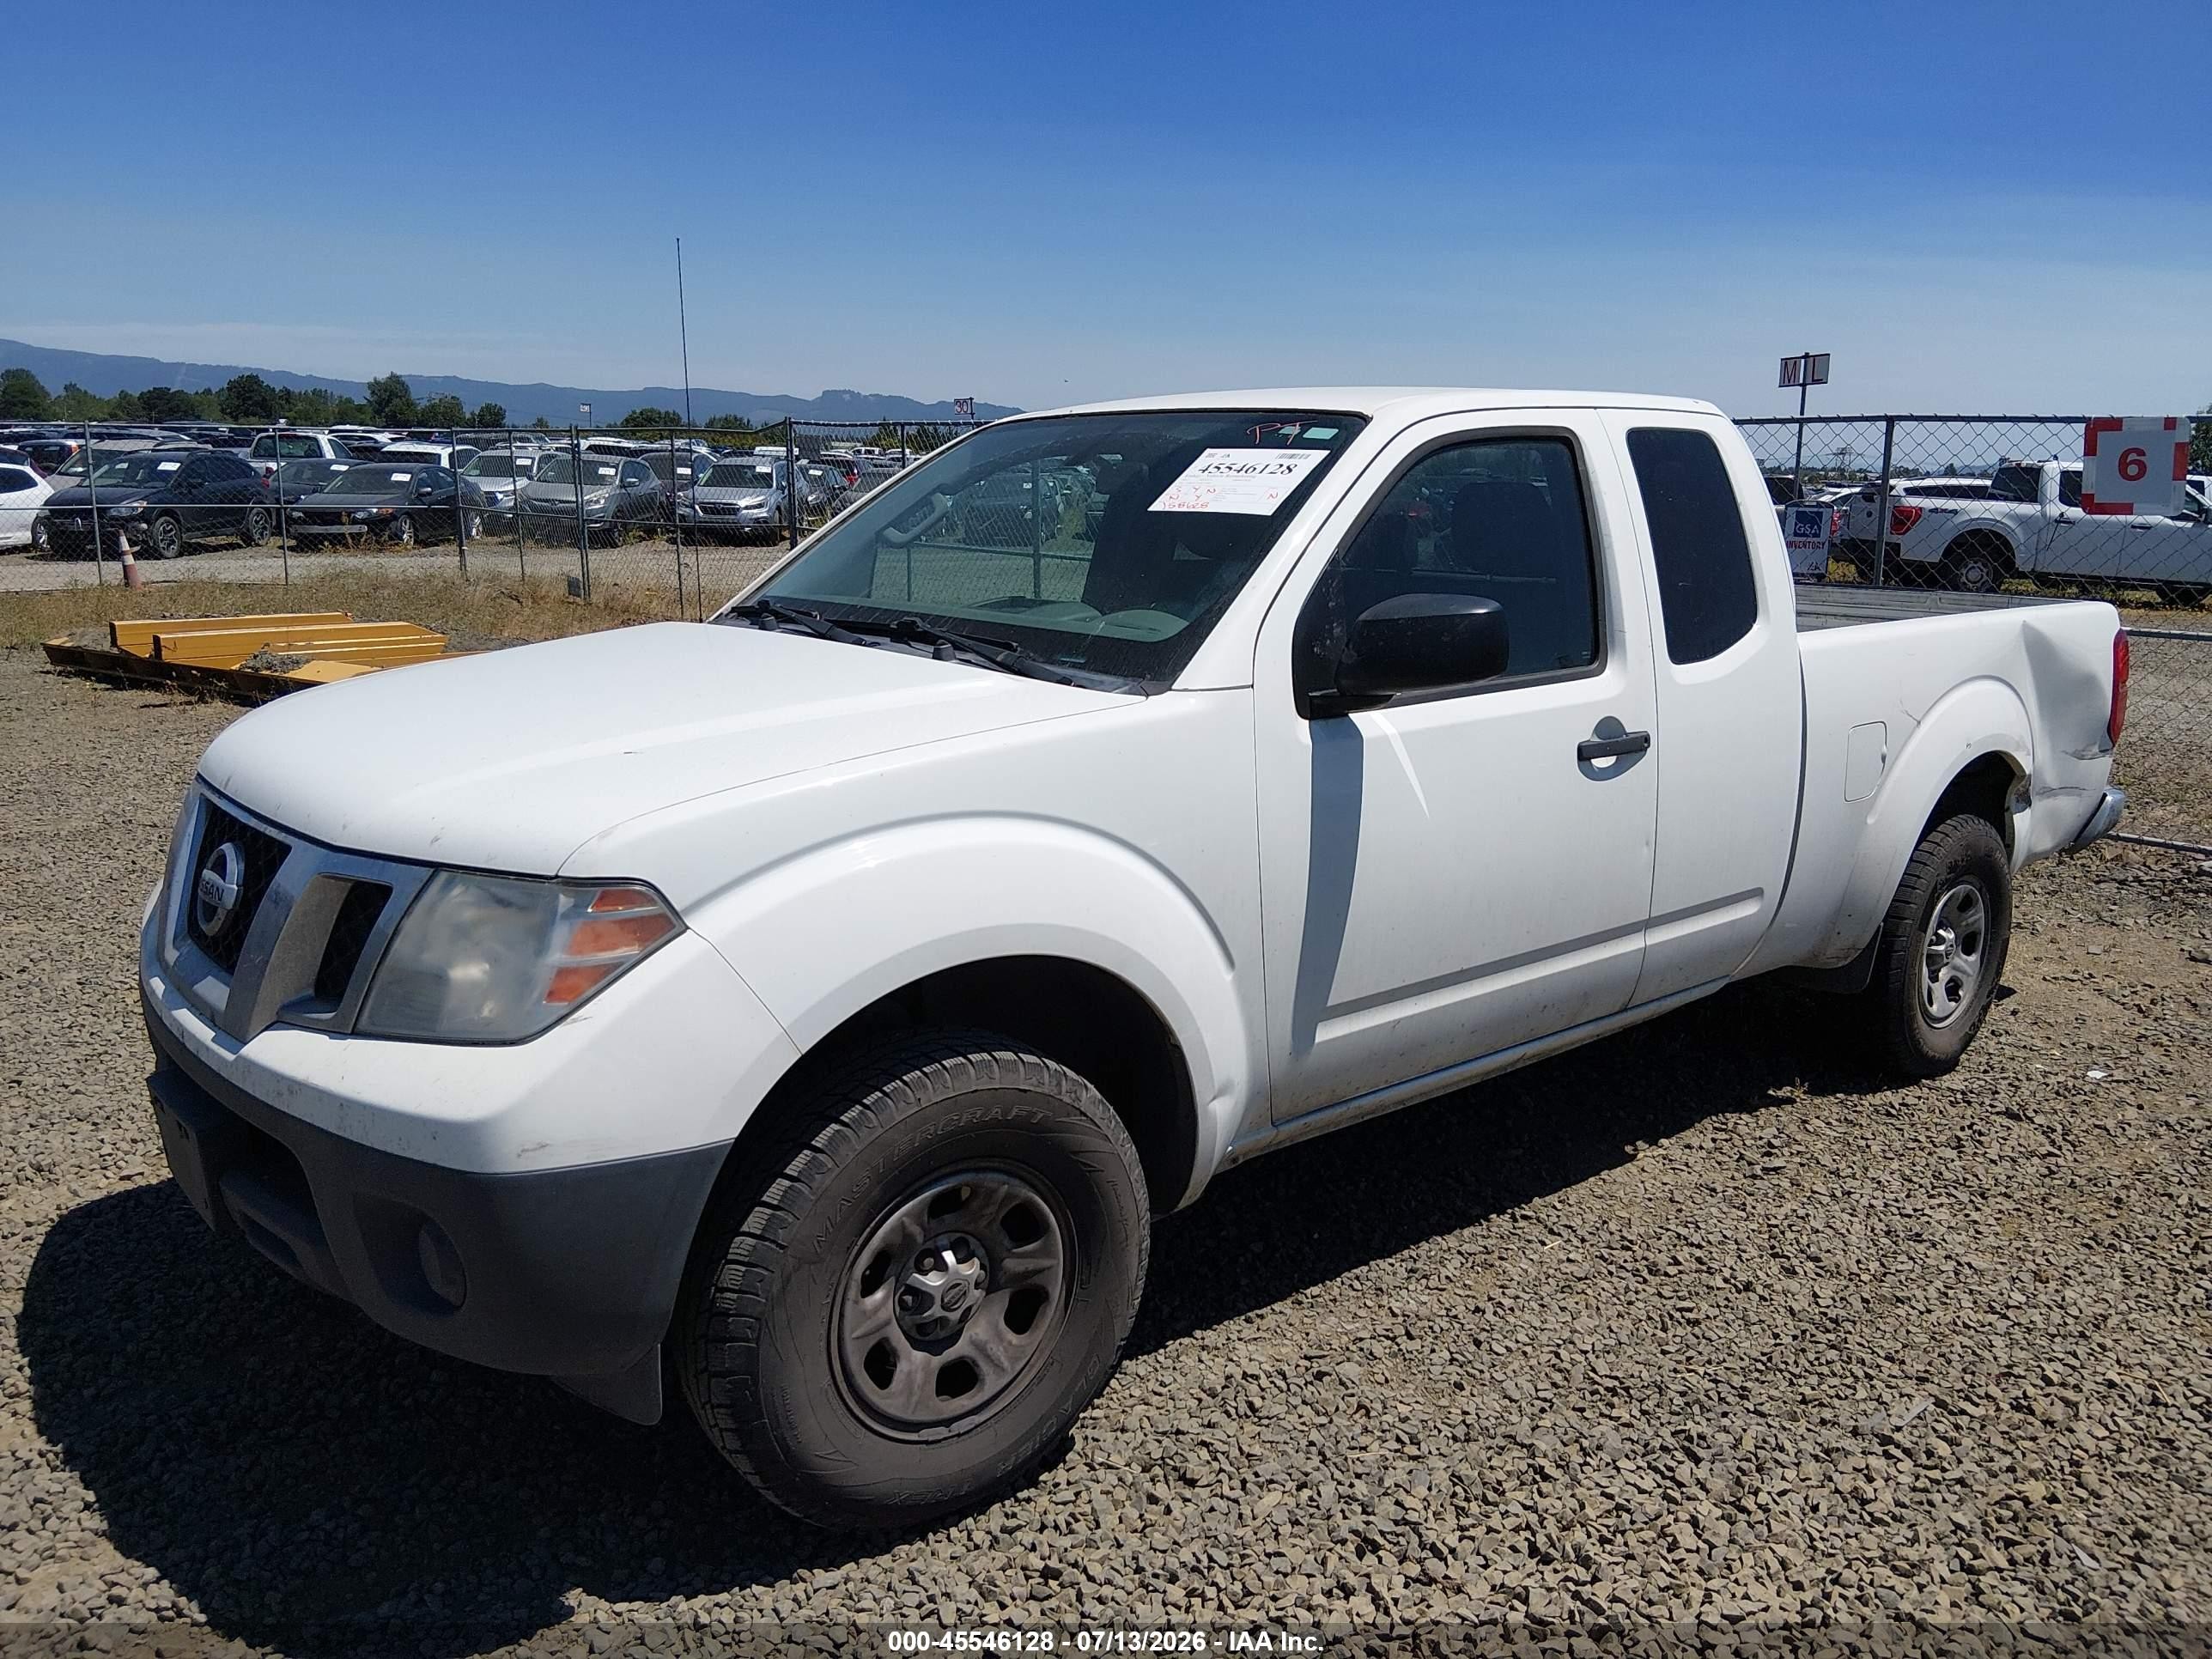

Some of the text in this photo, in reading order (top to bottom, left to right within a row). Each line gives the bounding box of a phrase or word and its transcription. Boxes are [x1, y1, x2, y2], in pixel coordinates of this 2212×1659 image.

[1783, 361, 1796, 385] M
[1812, 357, 1824, 383] L
[955, 400, 969, 413] 30
[1198, 462, 1298, 476] 45546128
[2118, 447, 2148, 482] 6
[1795, 523, 1820, 534] GSA
[1786, 540, 1826, 550] INVENTORY
[811, 1104, 1053, 1254] MASTERCRAFT
